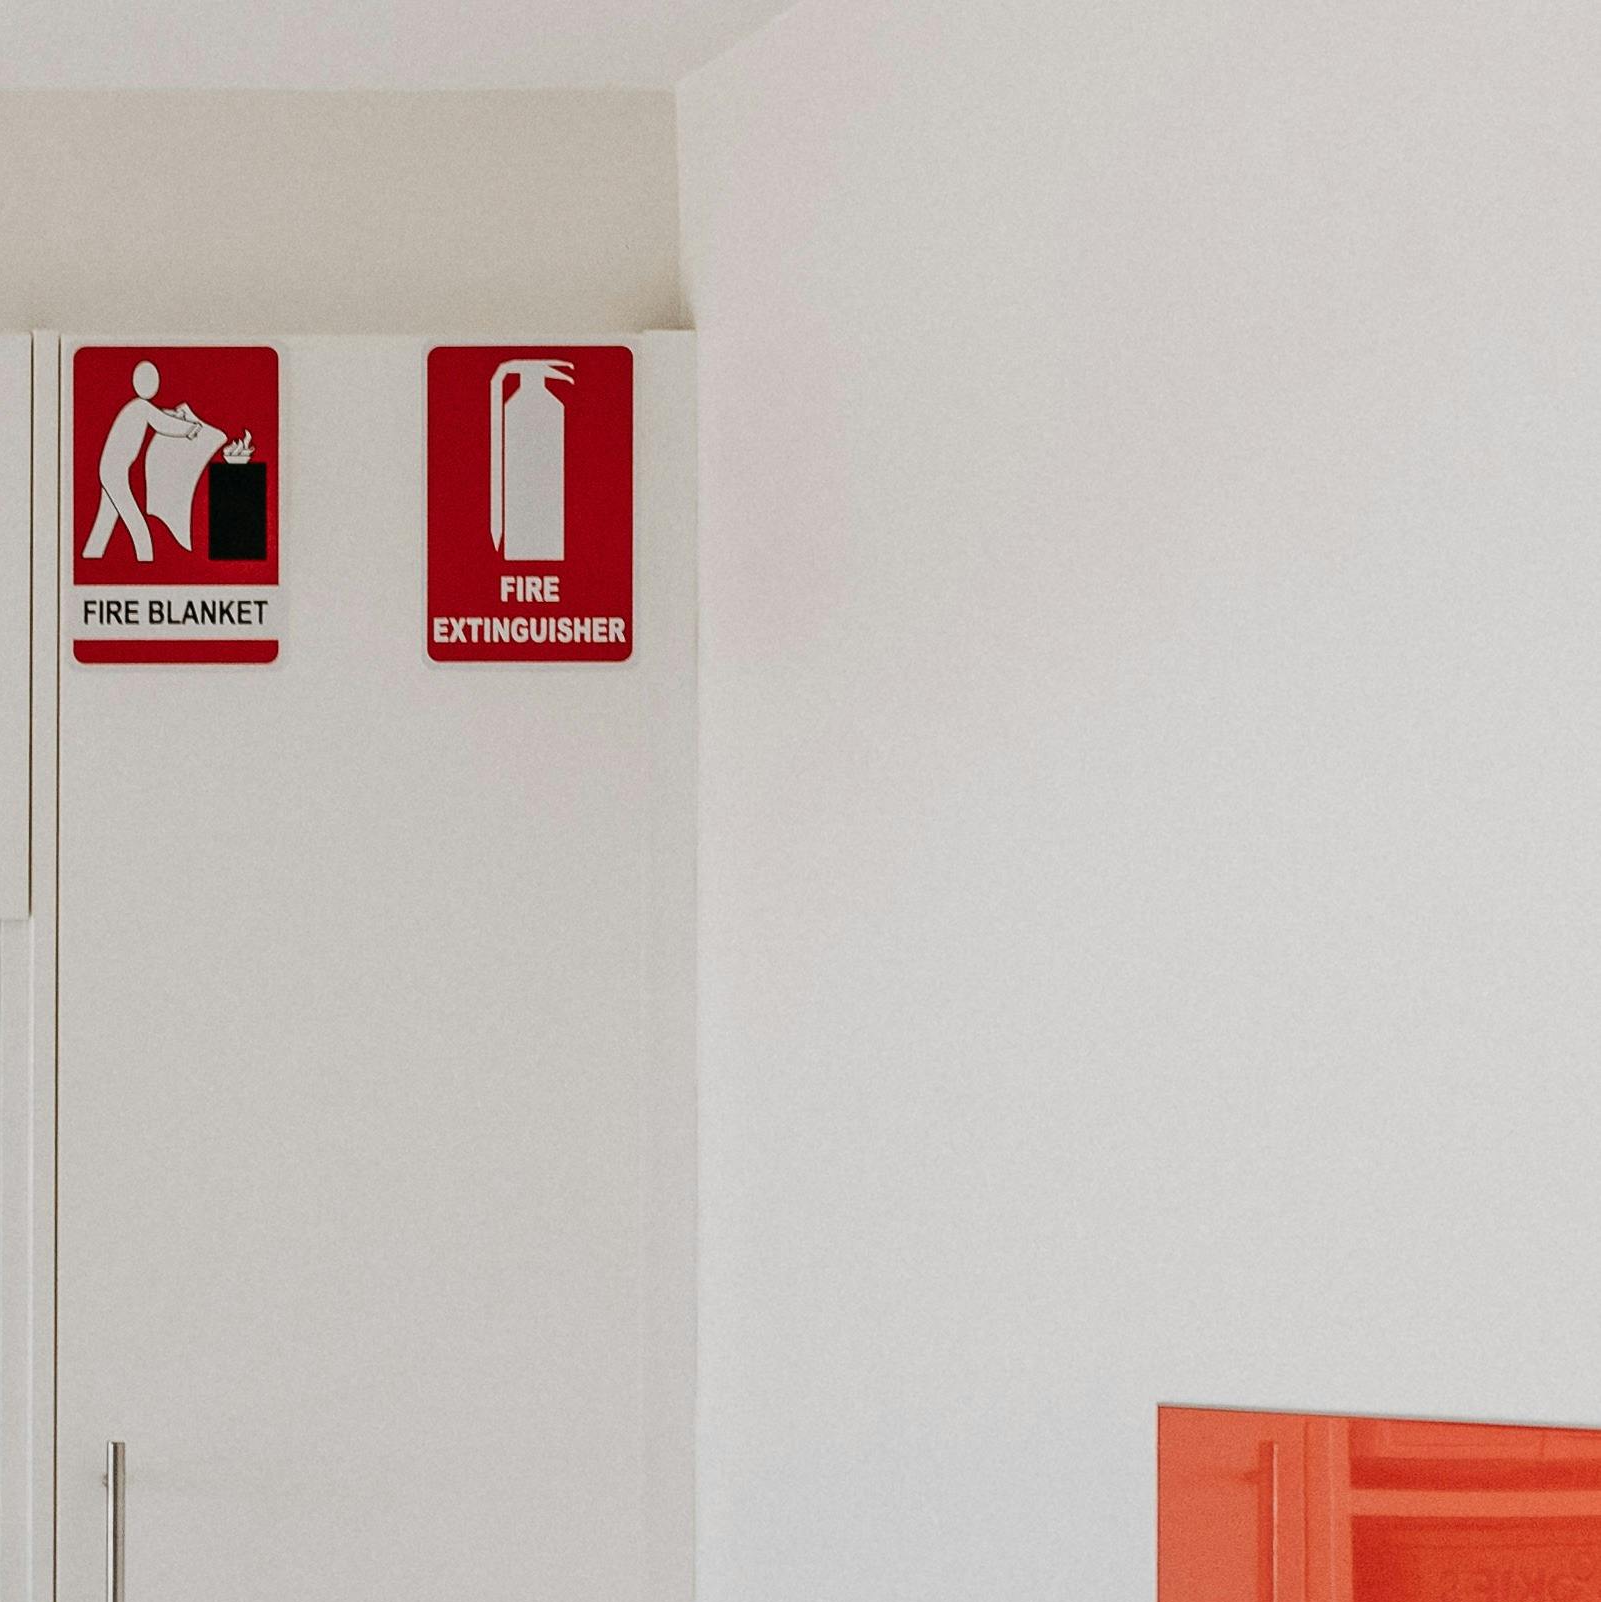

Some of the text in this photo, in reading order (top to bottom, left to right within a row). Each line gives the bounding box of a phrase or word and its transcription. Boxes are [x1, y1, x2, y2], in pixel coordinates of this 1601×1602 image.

[500, 576, 560, 603] FIRE
[83, 600, 268, 625] FIRE BLANKET
[433, 616, 626, 643] EXTINGUISHER
